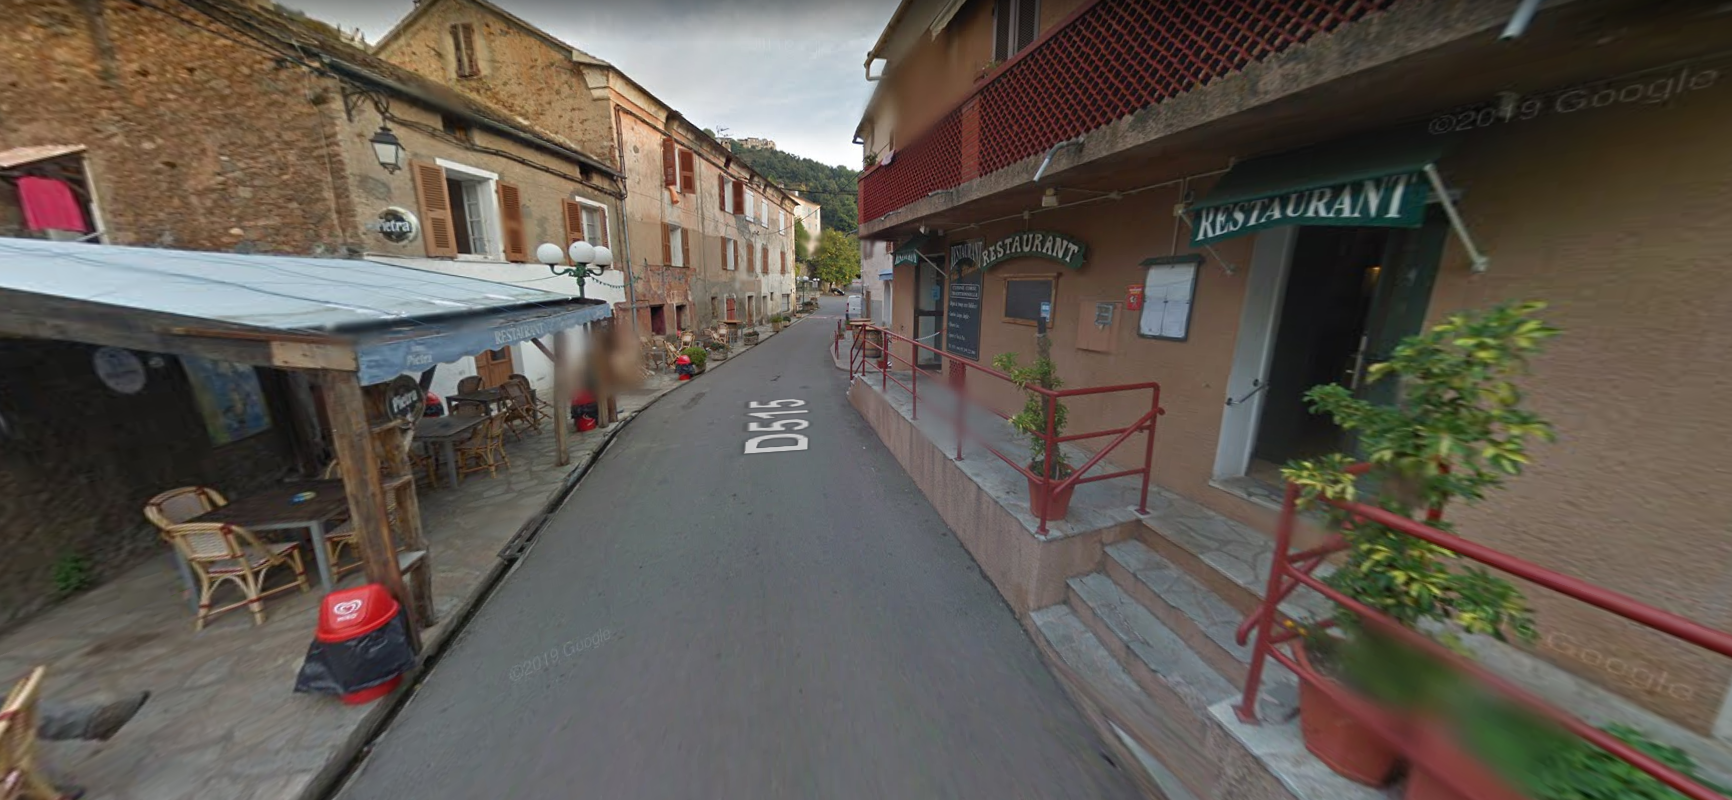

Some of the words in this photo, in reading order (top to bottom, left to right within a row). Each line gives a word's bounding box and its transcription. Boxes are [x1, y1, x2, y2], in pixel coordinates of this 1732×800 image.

[1195, 173, 1418, 242] RESTAURANT
[950, 241, 983, 271] RESTAURANT
[981, 233, 1080, 267] RESTAURANT
[744, 399, 809, 454] D515
